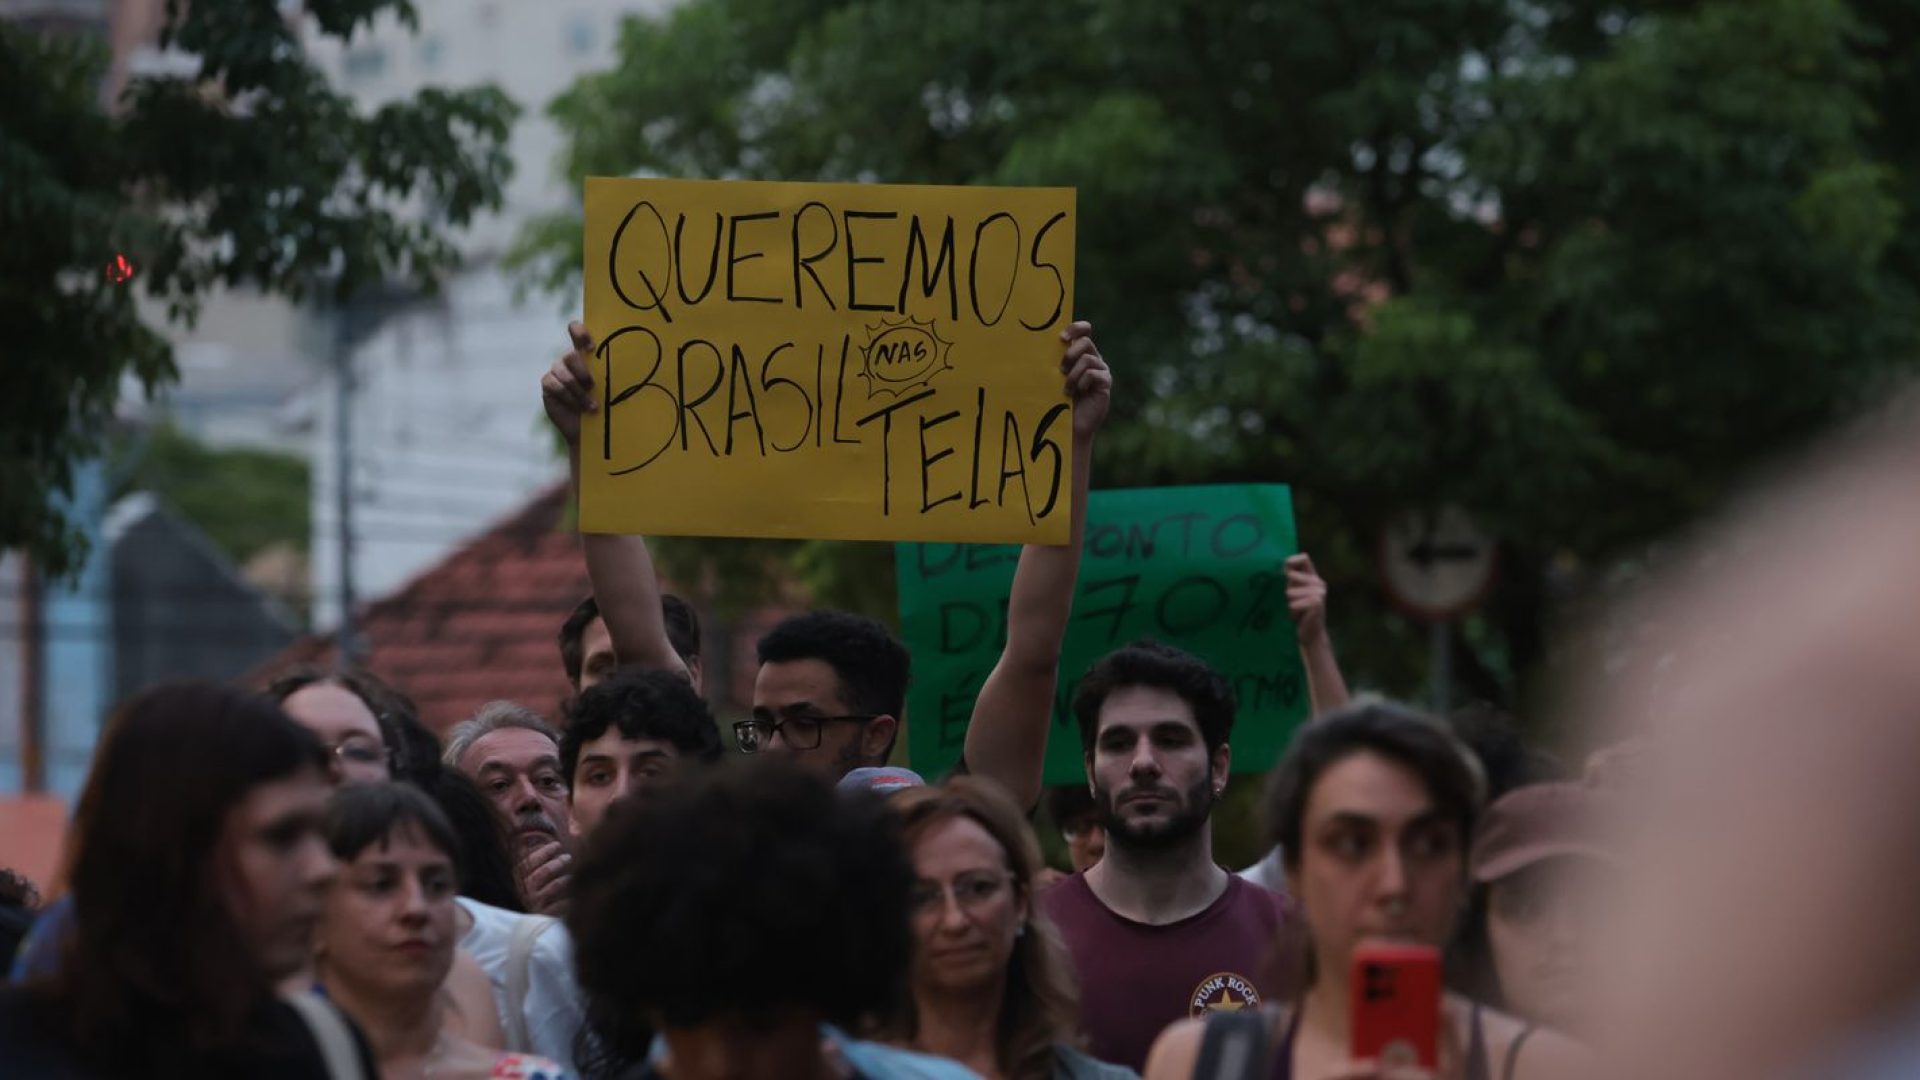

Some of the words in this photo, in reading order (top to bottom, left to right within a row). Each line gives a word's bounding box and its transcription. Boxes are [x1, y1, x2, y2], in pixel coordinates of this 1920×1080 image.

[609, 201, 1067, 331] QUEREMOS
[596, 326, 862, 475] BRASIL
[875, 344, 928, 365] NAS
[856, 387, 1071, 526] TELAS
[1078, 572, 1277, 642] 70%
[1194, 976, 1225, 1008] PUNK
[1226, 976, 1258, 1006] ROCK
